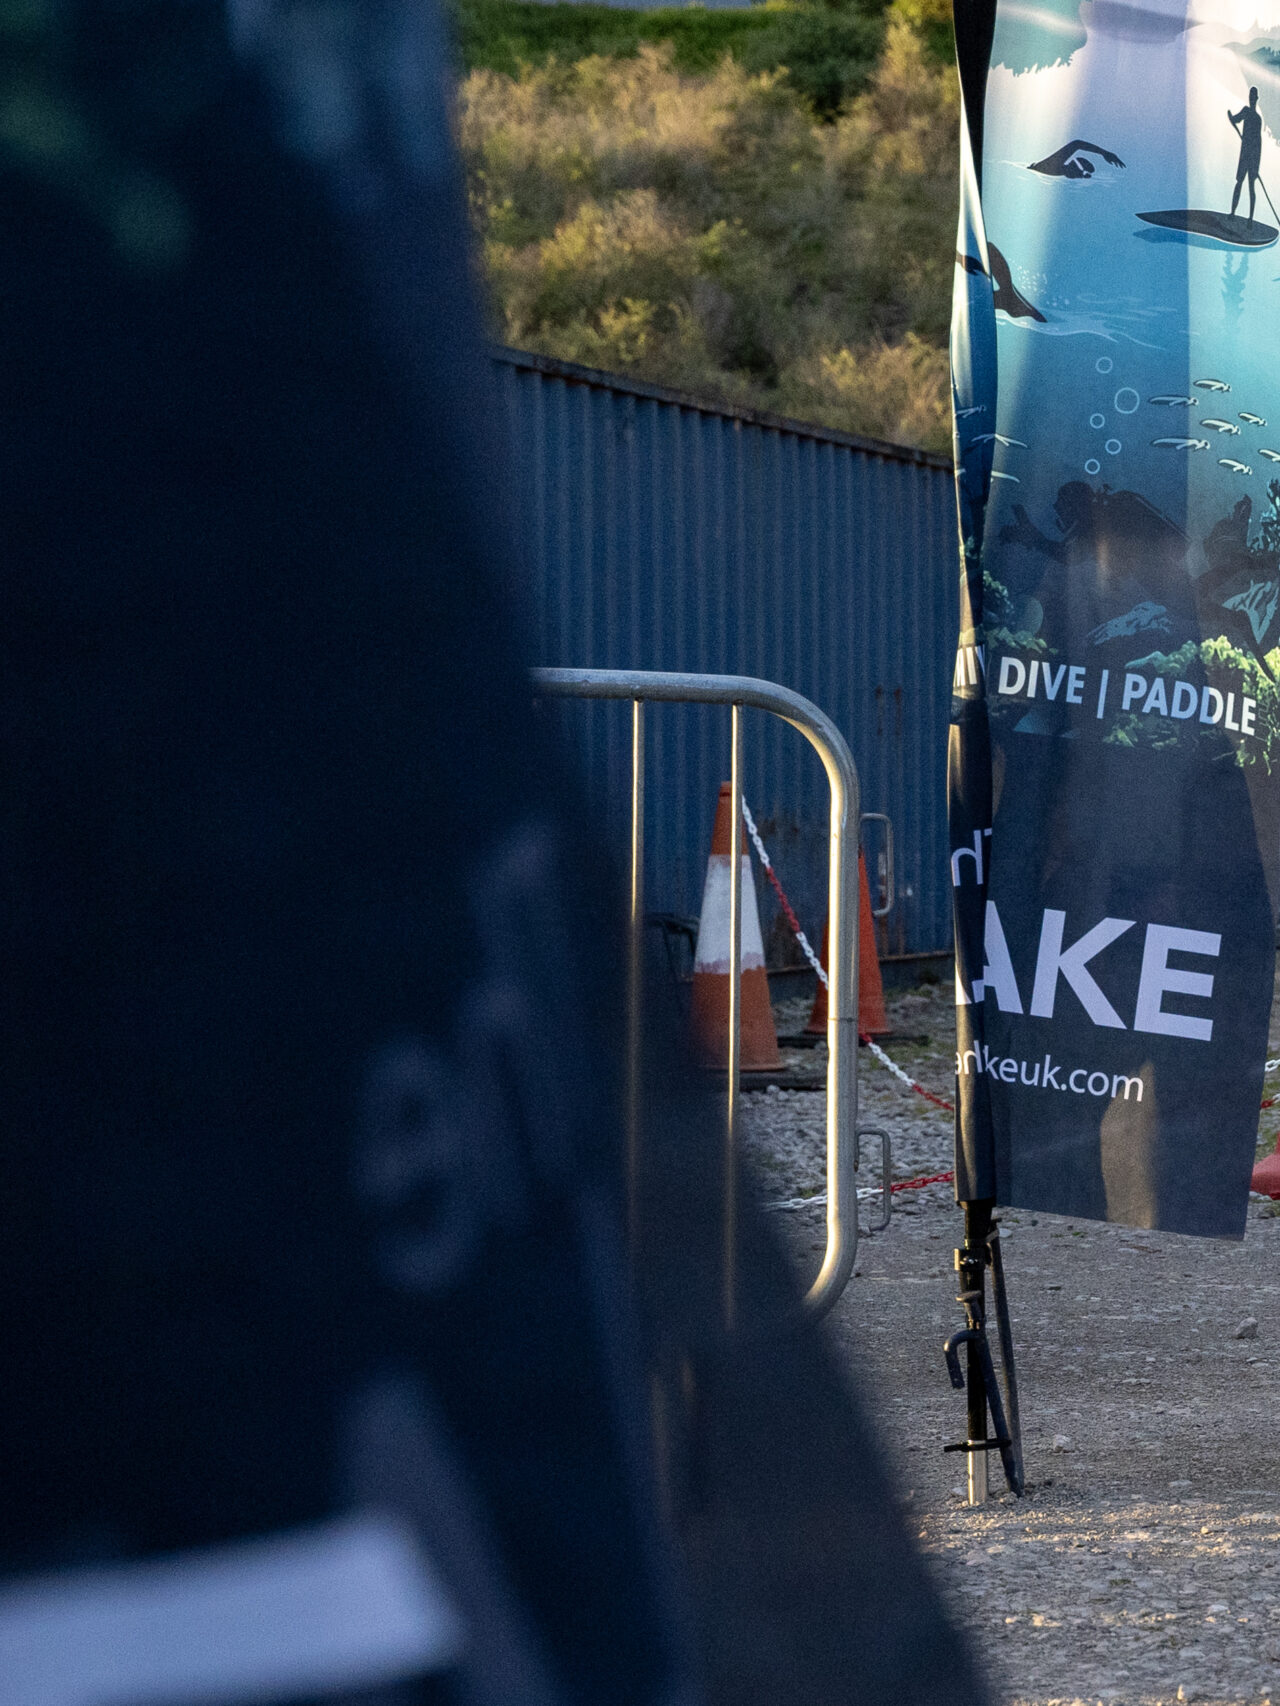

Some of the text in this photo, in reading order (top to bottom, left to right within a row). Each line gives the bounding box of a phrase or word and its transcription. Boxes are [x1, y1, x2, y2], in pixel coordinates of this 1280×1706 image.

[998, 656, 1086, 705] DIVE
[1121, 673, 1257, 736] PADDLE
[984, 899, 1222, 1042] AKE
